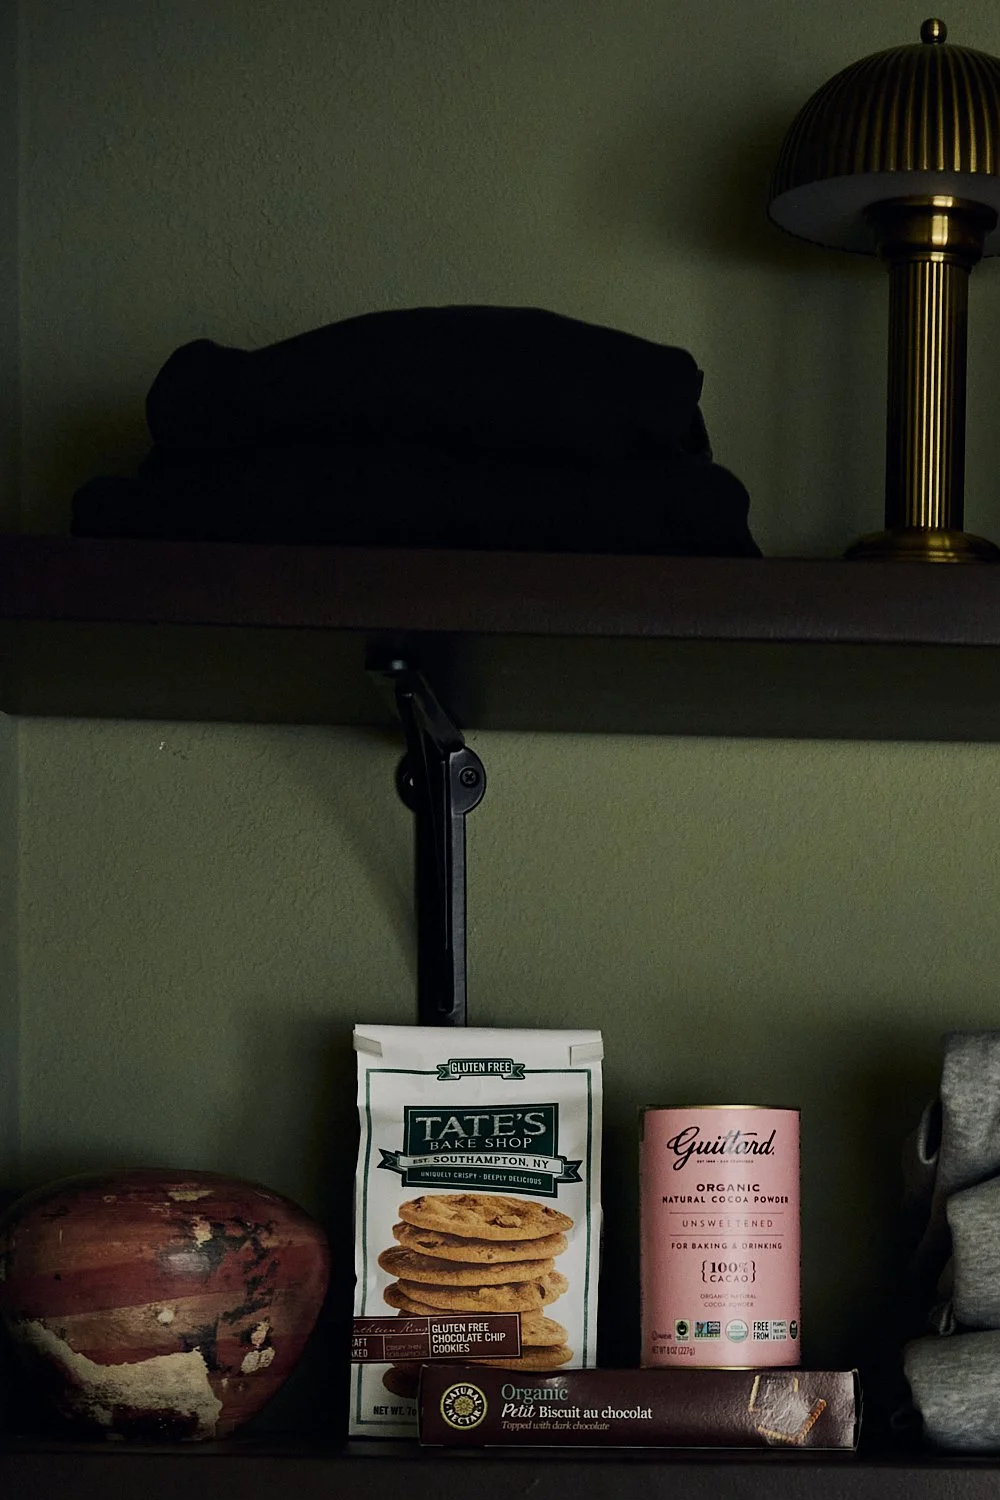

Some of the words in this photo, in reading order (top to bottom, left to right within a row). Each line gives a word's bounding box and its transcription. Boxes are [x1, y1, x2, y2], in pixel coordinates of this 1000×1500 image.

[451, 1062, 485, 1073] GLUTEN
[488, 1062, 511, 1073] FREE
[416, 1112, 547, 1141] TATE'S
[430, 1138, 477, 1151] BAKE
[485, 1137, 532, 1149] SHOP
[533, 1158, 549, 1169] NY
[483, 1173, 507, 1182] DEEPLY
[509, 1175, 542, 1185] DELICIOUS
[696, 1183, 760, 1192] ORGANIC
[662, 1196, 706, 1204] NATURAL
[711, 1196, 748, 1204] COCOA
[754, 1196, 789, 1204] POWDER
[682, 1220, 773, 1228] UNSWEETENED
[691, 1242, 728, 1250] BAKING
[742, 1242, 782, 1250] DRINKING
[709, 1274, 749, 1283] CACAO
[432, 1323, 467, 1333] GLUTEN
[468, 1323, 489, 1332] FREE
[753, 1321, 768, 1331] FREE
[432, 1333, 483, 1344] CHOCOLATE
[485, 1332, 506, 1342] CHIP
[753, 1331, 769, 1340] FROM
[433, 1343, 470, 1354] COOKIES
[445, 1386, 482, 1406] NATURAL
[501, 1383, 568, 1405] Organic
[373, 1406, 388, 1415] NET
[446, 1407, 482, 1425] NECTAR
[501, 1403, 537, 1418] Petit
[539, 1406, 581, 1419] Biscuit
[583, 1409, 599, 1419] au
[601, 1407, 653, 1419] chocolat
[502, 1421, 532, 1431] Topped
[533, 1421, 550, 1430] with
[552, 1421, 571, 1430] dark
[572, 1421, 610, 1431] chocolate
